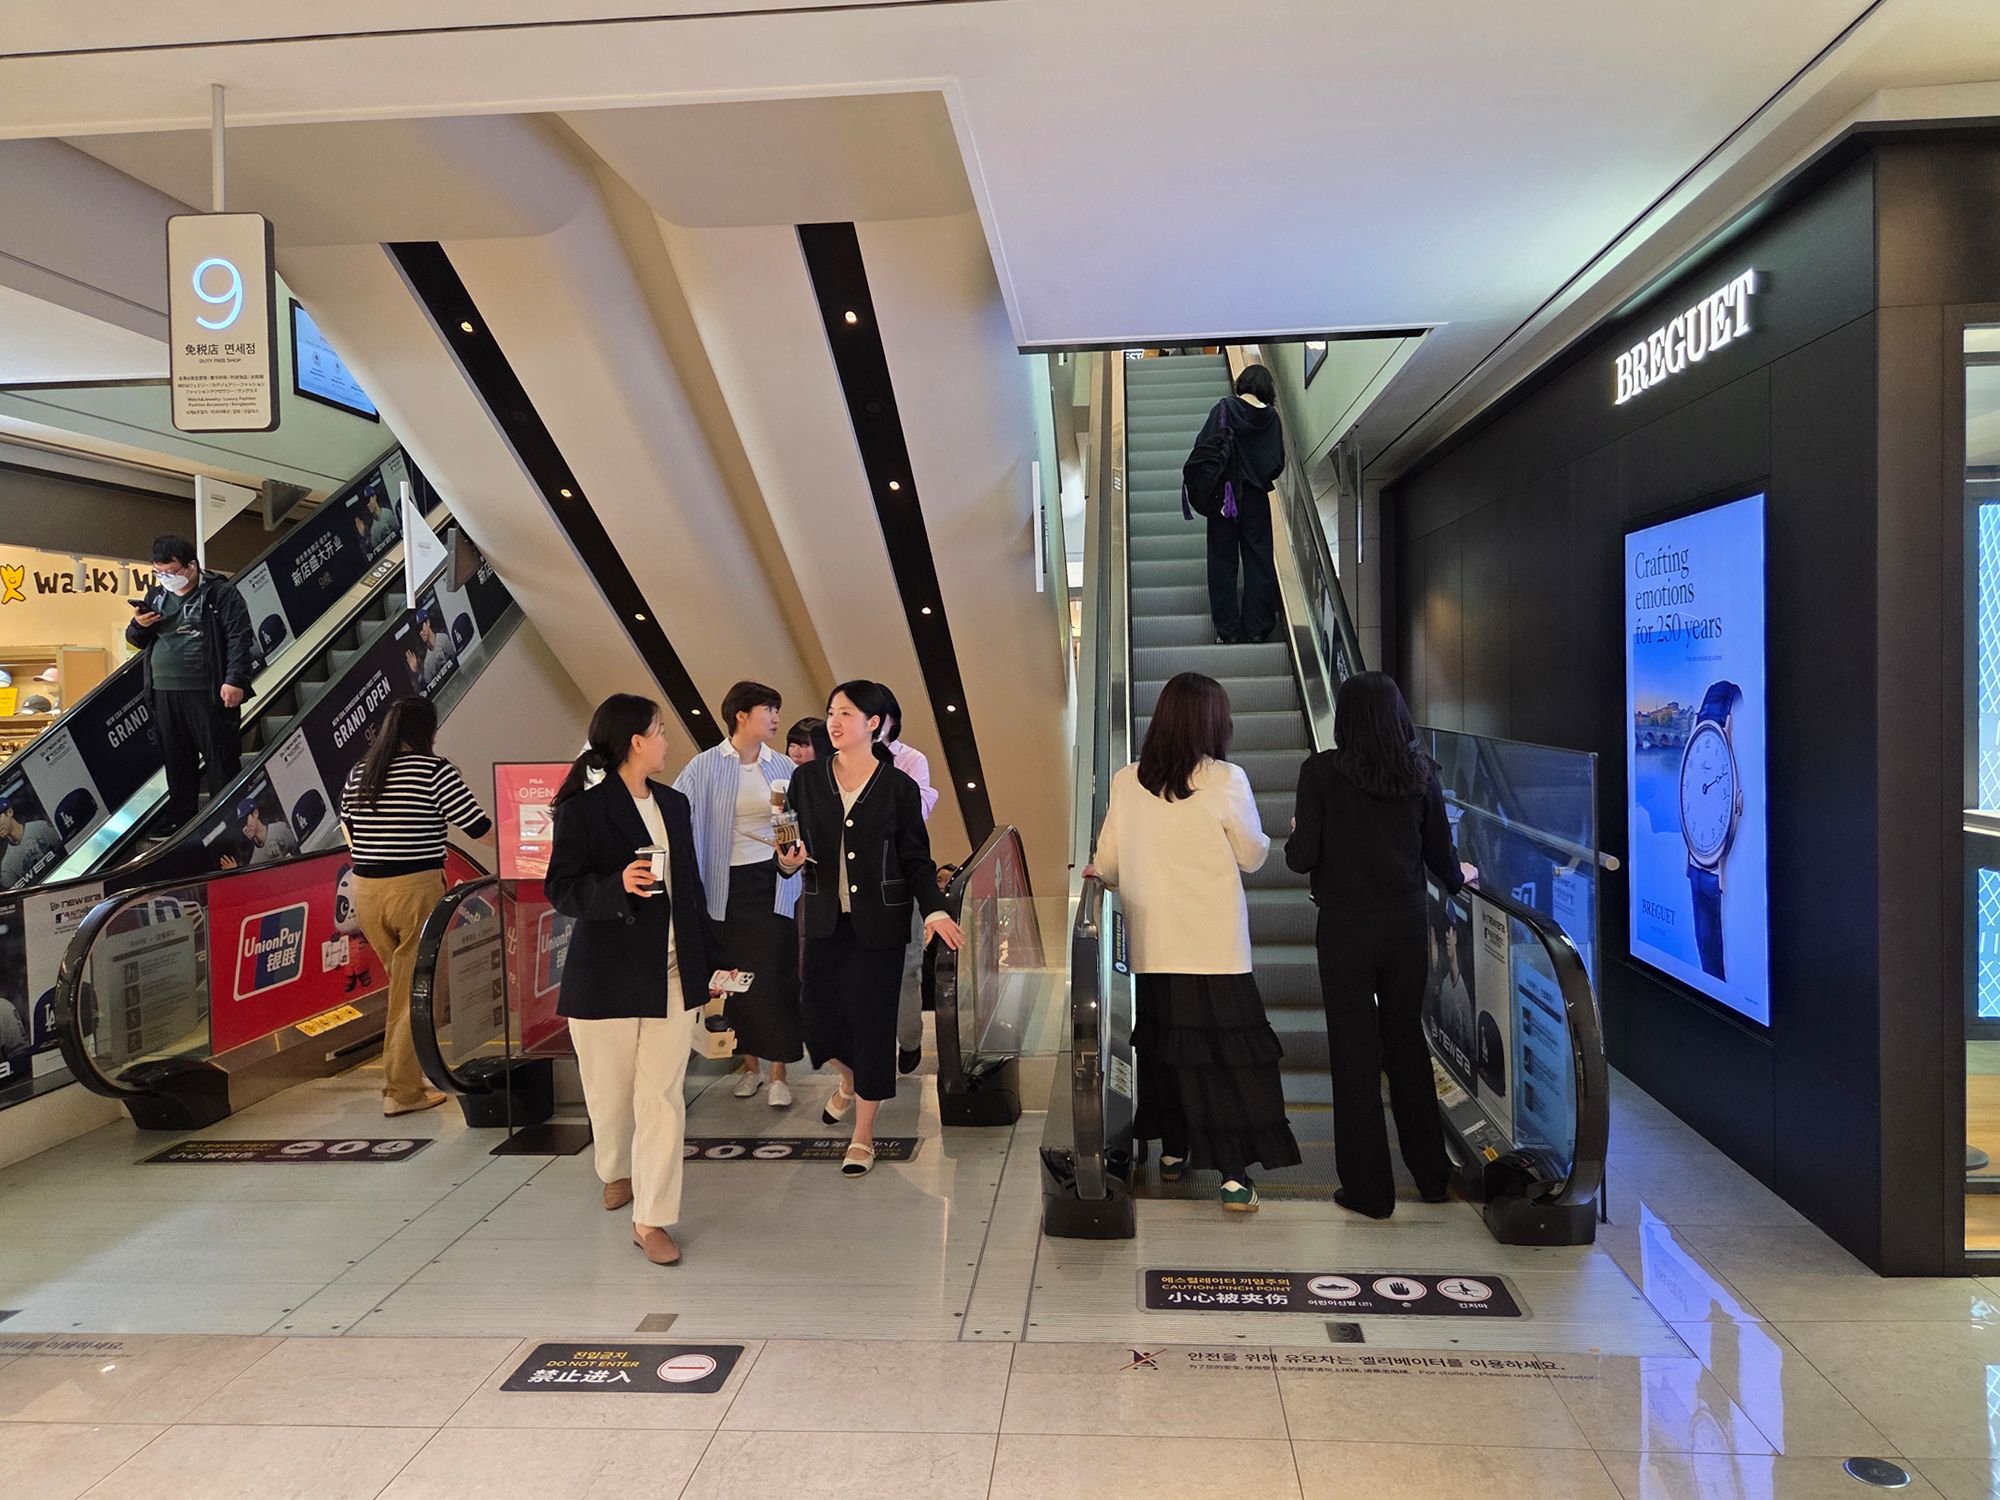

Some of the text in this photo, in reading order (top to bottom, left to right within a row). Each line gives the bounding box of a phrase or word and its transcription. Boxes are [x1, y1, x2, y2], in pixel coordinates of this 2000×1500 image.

[192, 257, 244, 330] 9
[185, 343, 256, 356] 免税店 면세점
[1614, 268, 1755, 405] BREGUET
[1635, 545, 1689, 579] Crafting
[1635, 579, 1695, 610] emotions
[1635, 613, 1722, 648] for 250 years
[108, 704, 149, 748] GRAND
[333, 676, 391, 749] GRAND OPEN
[519, 787, 555, 798] OPEN
[1641, 898, 1676, 926] BREGUET
[244, 927, 301, 957] UnionPay
[541, 924, 572, 953] UnionP
[266, 947, 297, 972] 银联
[1161, 1276, 1290, 1286] 에스컬레이터 끼임주의
[1167, 1292, 1289, 1305] 小心被夹伤
[573, 1351, 628, 1360] 진입금지
[1187, 1352, 1566, 1371] 안전을 위해 유모차는 엘리베이터를 이용하세요.
[528, 1369, 632, 1383] 禁止进入
